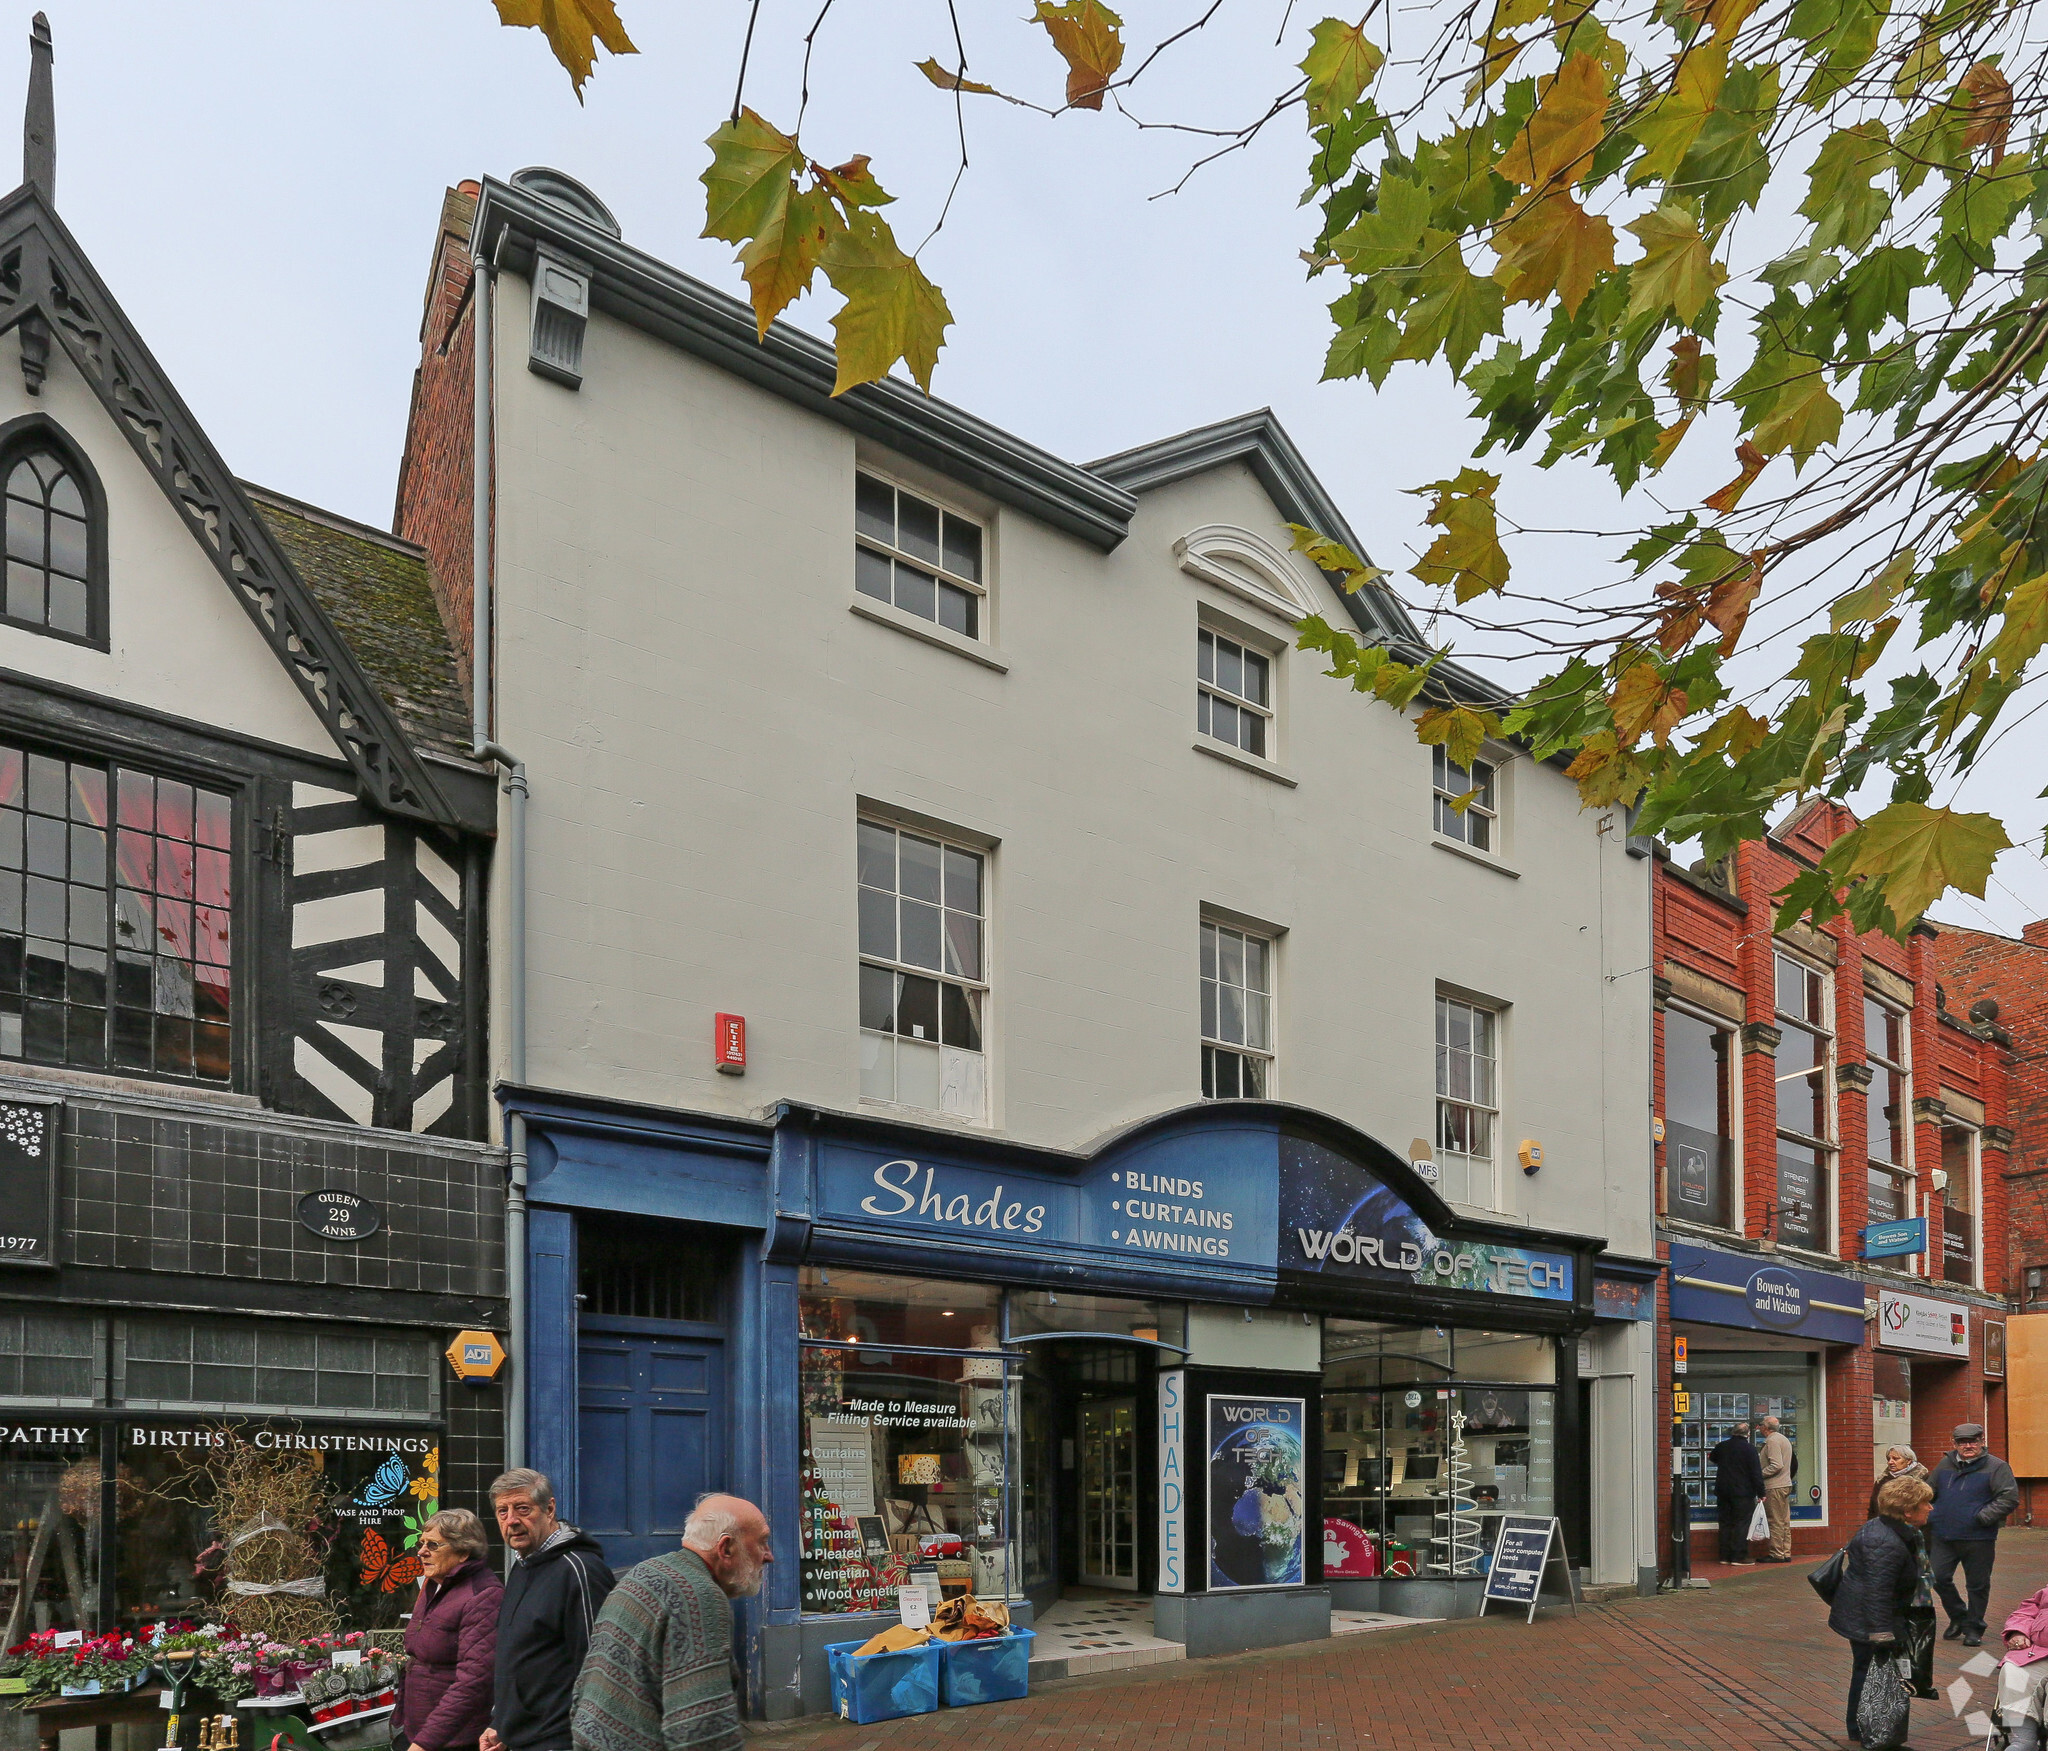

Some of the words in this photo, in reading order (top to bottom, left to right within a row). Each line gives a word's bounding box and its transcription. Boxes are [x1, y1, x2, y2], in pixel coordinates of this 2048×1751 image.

[730, 1023, 739, 1052] ELITE
[1418, 1163, 1438, 1178] MFS
[1783, 1171, 1809, 1184] STRENGTH
[1126, 1170, 1204, 1199] BLINDS
[1786, 1185, 1806, 1196] FITNESS
[318, 1193, 360, 1208] QUEEN
[861, 1160, 1045, 1233] Shades
[1800, 1202, 1813, 1210] GAIN
[329, 1208, 350, 1222] 29
[1125, 1200, 1233, 1230] CURTAINS
[321, 1225, 357, 1236] ANNE
[1783, 1222, 1809, 1234] NUTRITION
[1125, 1228, 1229, 1256] AWNINGS
[1299, 1228, 1422, 1271] WORLD
[1434, 1251, 1474, 1276] OF
[1490, 1255, 1563, 1289] TECH
[1756, 1277, 1784, 1296] Bowen
[1785, 1282, 1800, 1298] Son
[1755, 1296, 1770, 1311] and
[1772, 1299, 1801, 1315] Watson
[1884, 1300, 1911, 1330] KSP
[465, 1348, 491, 1360] ADT
[850, 1399, 885, 1413] Made
[888, 1401, 900, 1413] to
[904, 1401, 956, 1414] Measure
[827, 1412, 870, 1427] Fitting
[873, 1415, 920, 1427] Service
[923, 1417, 977, 1429] available
[1223, 1406, 1291, 1423] WORLD
[132, 1428, 225, 1447] BIRTHS
[255, 1431, 429, 1452] CHRISTENINGS
[1245, 1429, 1270, 1443] OF
[813, 1448, 866, 1459] Curtains
[1232, 1448, 1283, 1464] TECH
[813, 1468, 854, 1479] Blinds
[1163, 1376, 1181, 1588] SHADES
[814, 1488, 862, 1499] Vertical
[814, 1508, 851, 1519] Roller
[814, 1528, 859, 1539] Roman
[1336, 1519, 1363, 1539] Savings
[1362, 1539, 1372, 1557] Club
[815, 1548, 862, 1560] Pleated
[1503, 1548, 1515, 1556] your
[815, 1568, 870, 1580] Venetian
[816, 1588, 852, 1600] Wood
[856, 1585, 899, 1599] venetia
